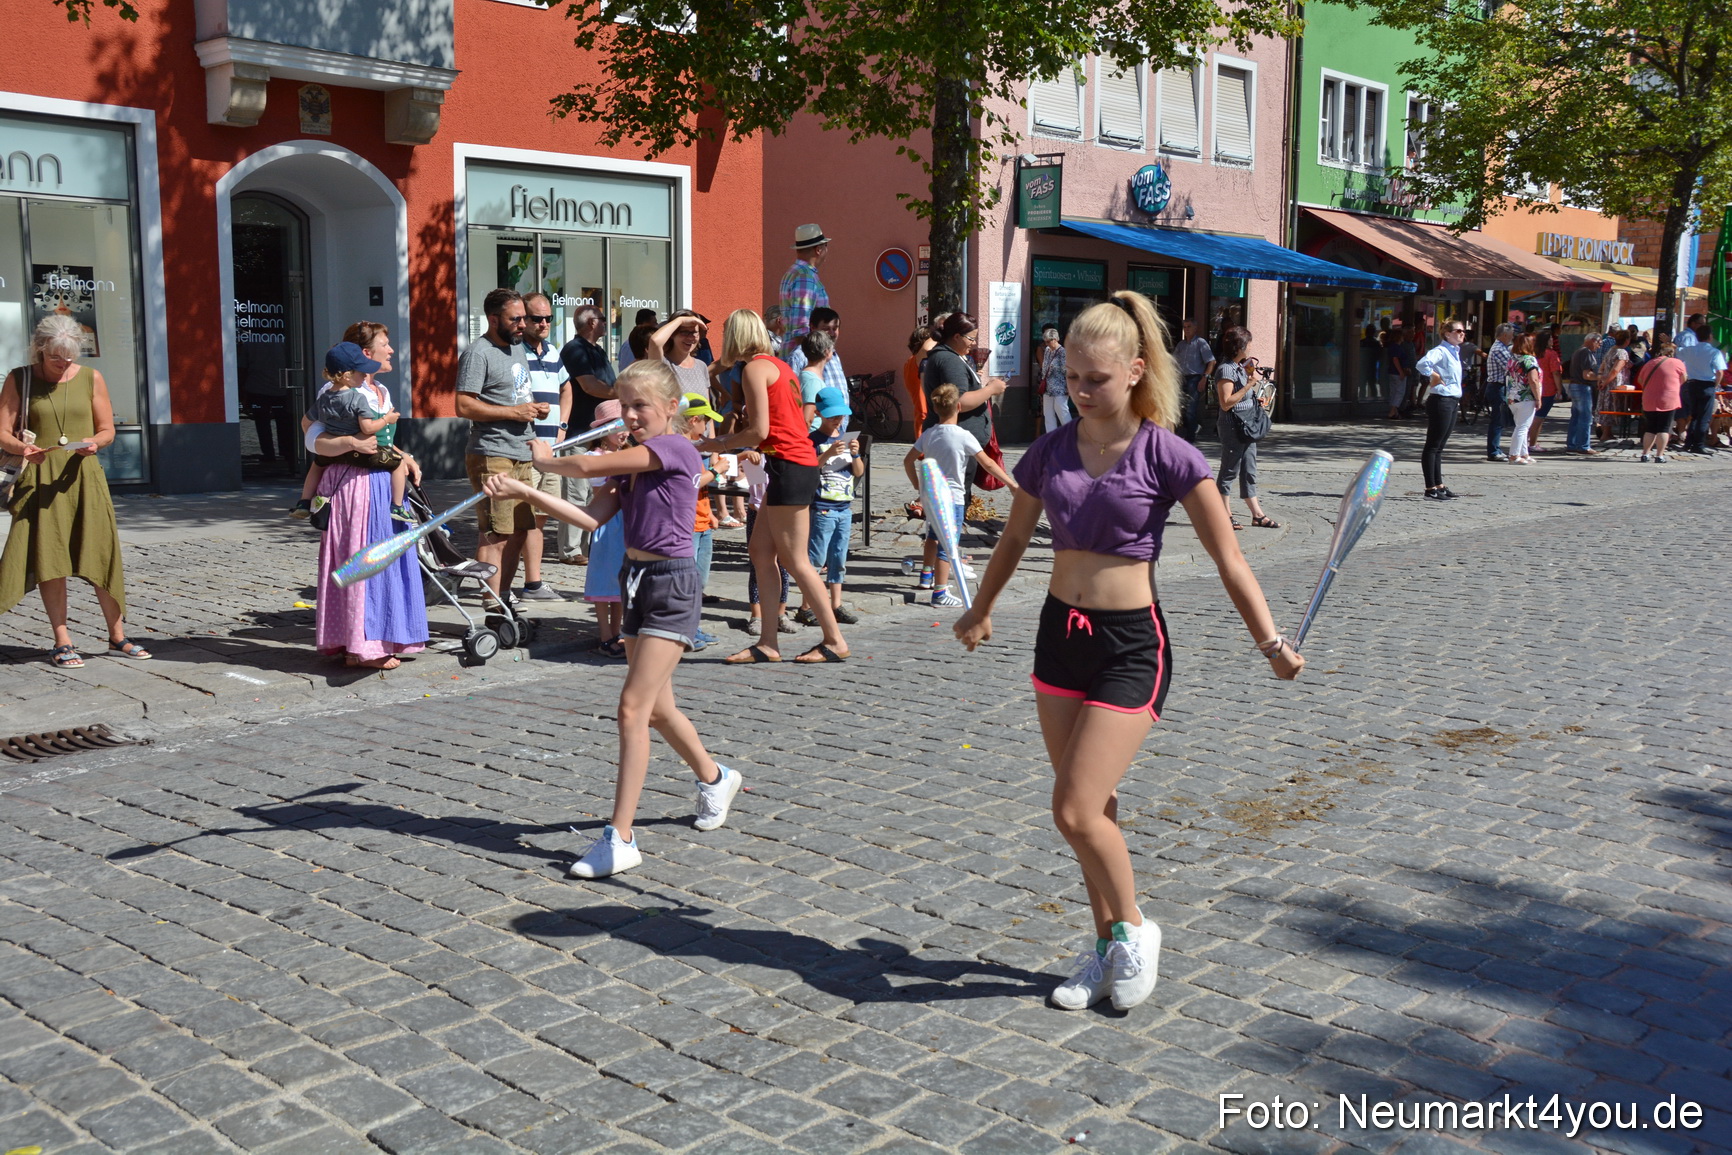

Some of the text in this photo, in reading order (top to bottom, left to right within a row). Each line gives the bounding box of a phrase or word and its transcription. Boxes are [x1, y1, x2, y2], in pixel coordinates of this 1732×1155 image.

[1025, 177, 1042, 190] vom
[1131, 169, 1154, 188] vom
[1030, 180, 1055, 199] FASS
[1138, 180, 1171, 208] FASS
[511, 184, 632, 227] fielmann
[1541, 231, 1575, 258] LEDER
[49, 273, 115, 292] fielmann
[1034, 266, 1103, 286] Spirituosen Whisky
[1138, 277, 1164, 289] Feinkost
[1213, 279, 1229, 292] Essig
[552, 293, 594, 306] fielmann
[619, 295, 659, 309] fielmann
[236, 329, 285, 343] ielmann
[998, 328, 1016, 343] FASS
